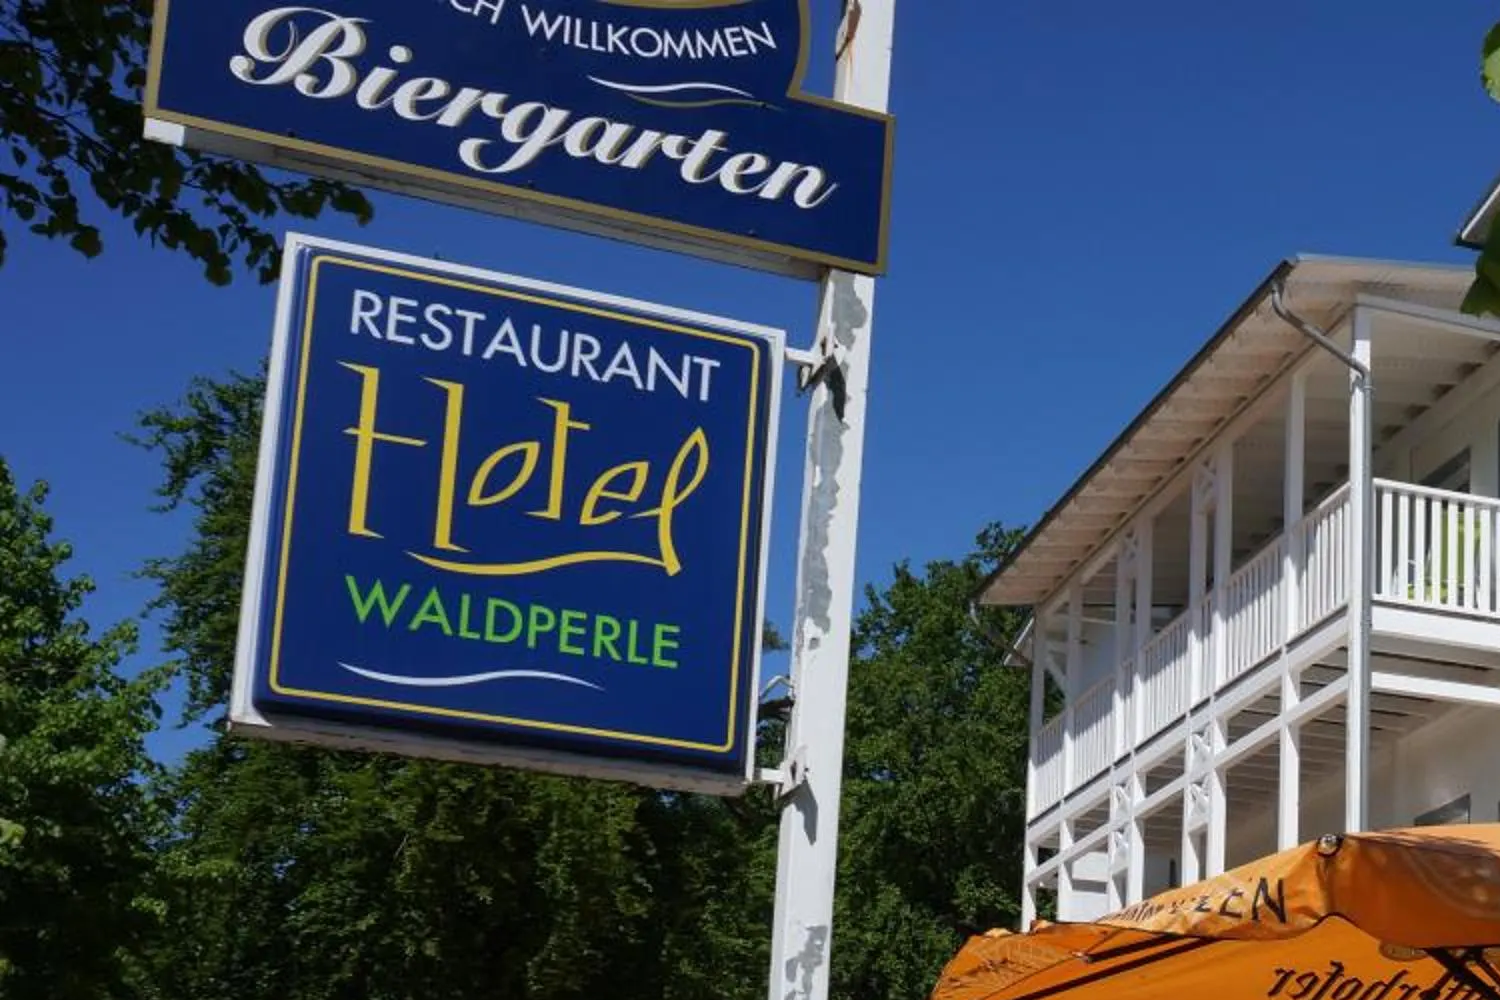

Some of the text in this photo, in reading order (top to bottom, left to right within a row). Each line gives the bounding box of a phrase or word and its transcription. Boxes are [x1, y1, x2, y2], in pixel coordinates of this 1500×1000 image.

[521, 5, 776, 58] WILLKOMMEN
[229, 6, 838, 209] Biergarten
[349, 289, 720, 401] RESTAURANT
[336, 360, 709, 576] Hotel
[345, 574, 681, 669] WALDPERLE
